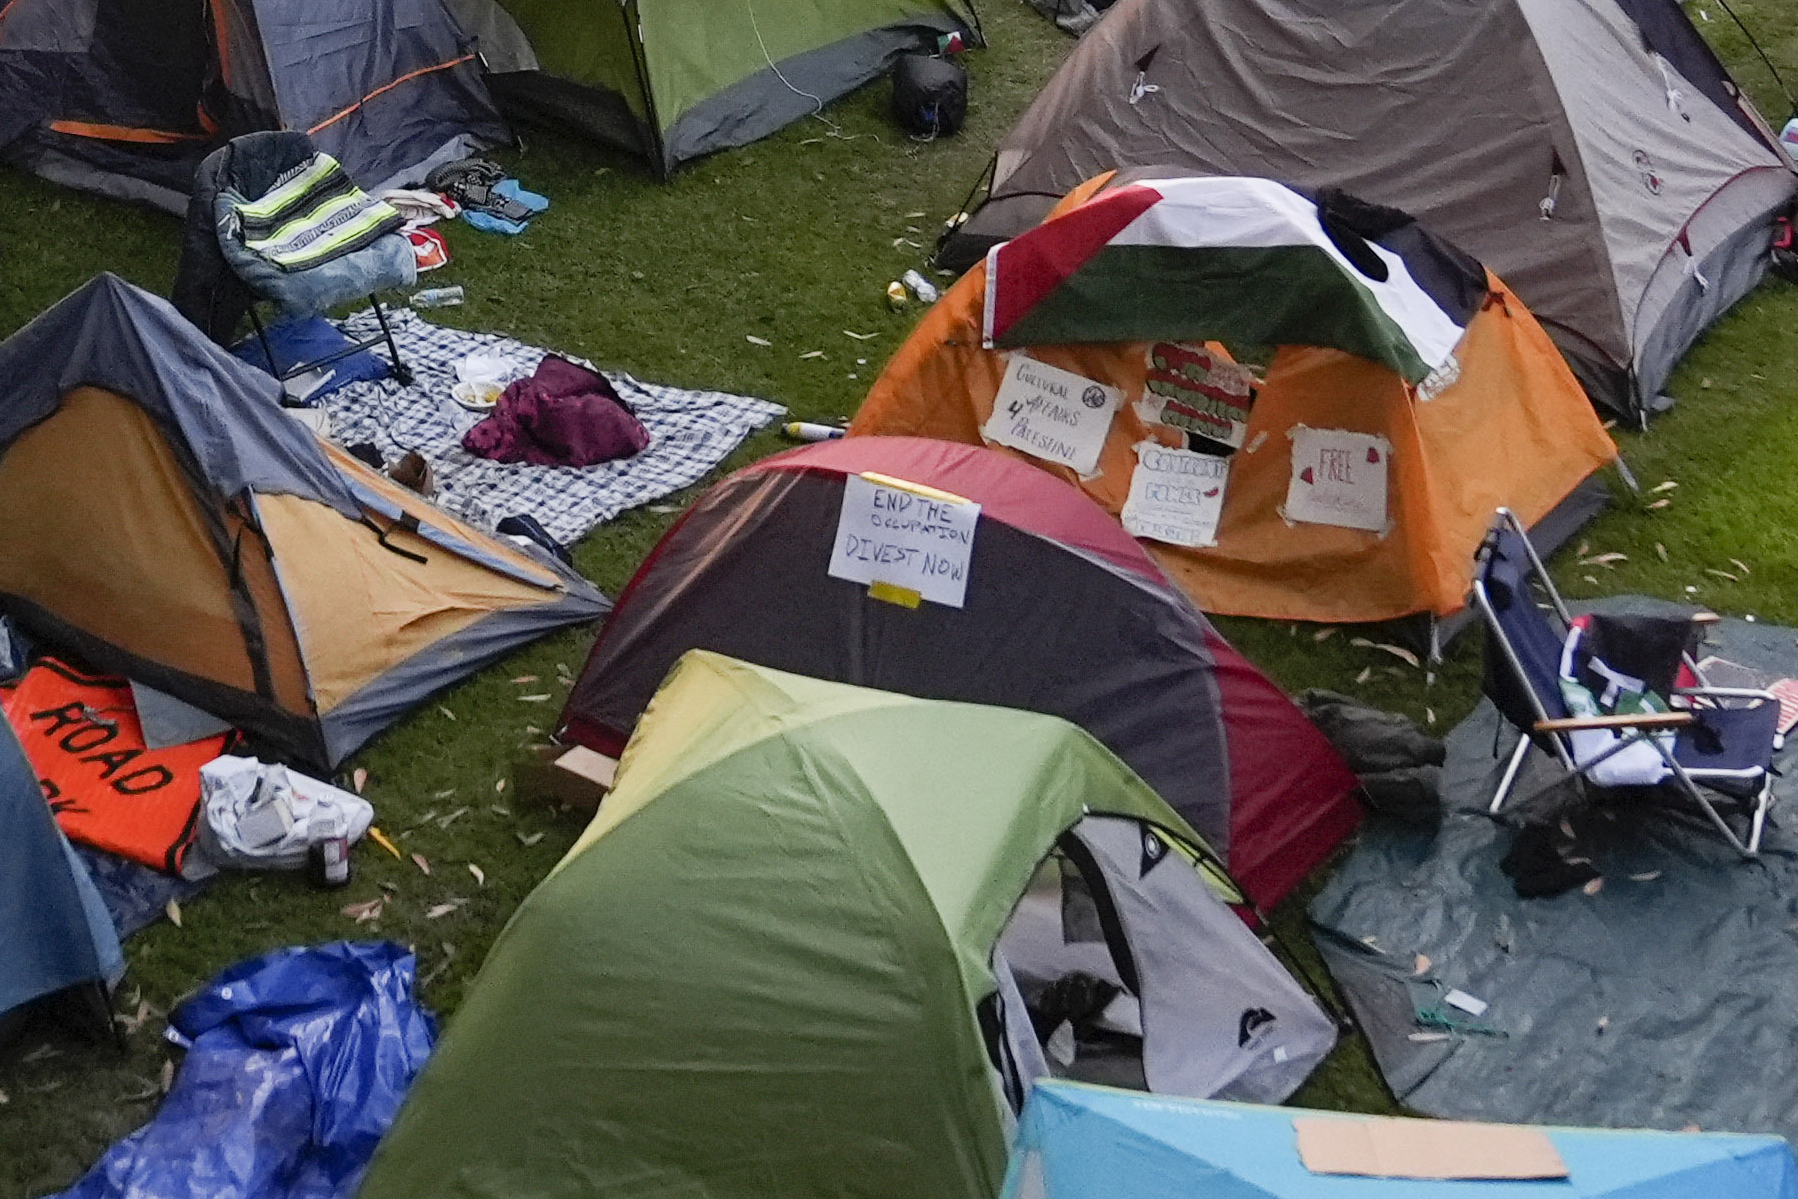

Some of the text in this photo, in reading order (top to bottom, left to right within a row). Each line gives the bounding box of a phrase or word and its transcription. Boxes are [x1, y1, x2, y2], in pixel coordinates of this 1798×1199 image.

[1007, 399, 1024, 420] 4
[1318, 447, 1354, 485] FREE
[873, 488, 953, 524] END THE
[870, 513, 970, 545] OCCUPATION
[845, 533, 964, 582] DIVEST NOW
[29, 701, 174, 795] ROAD
